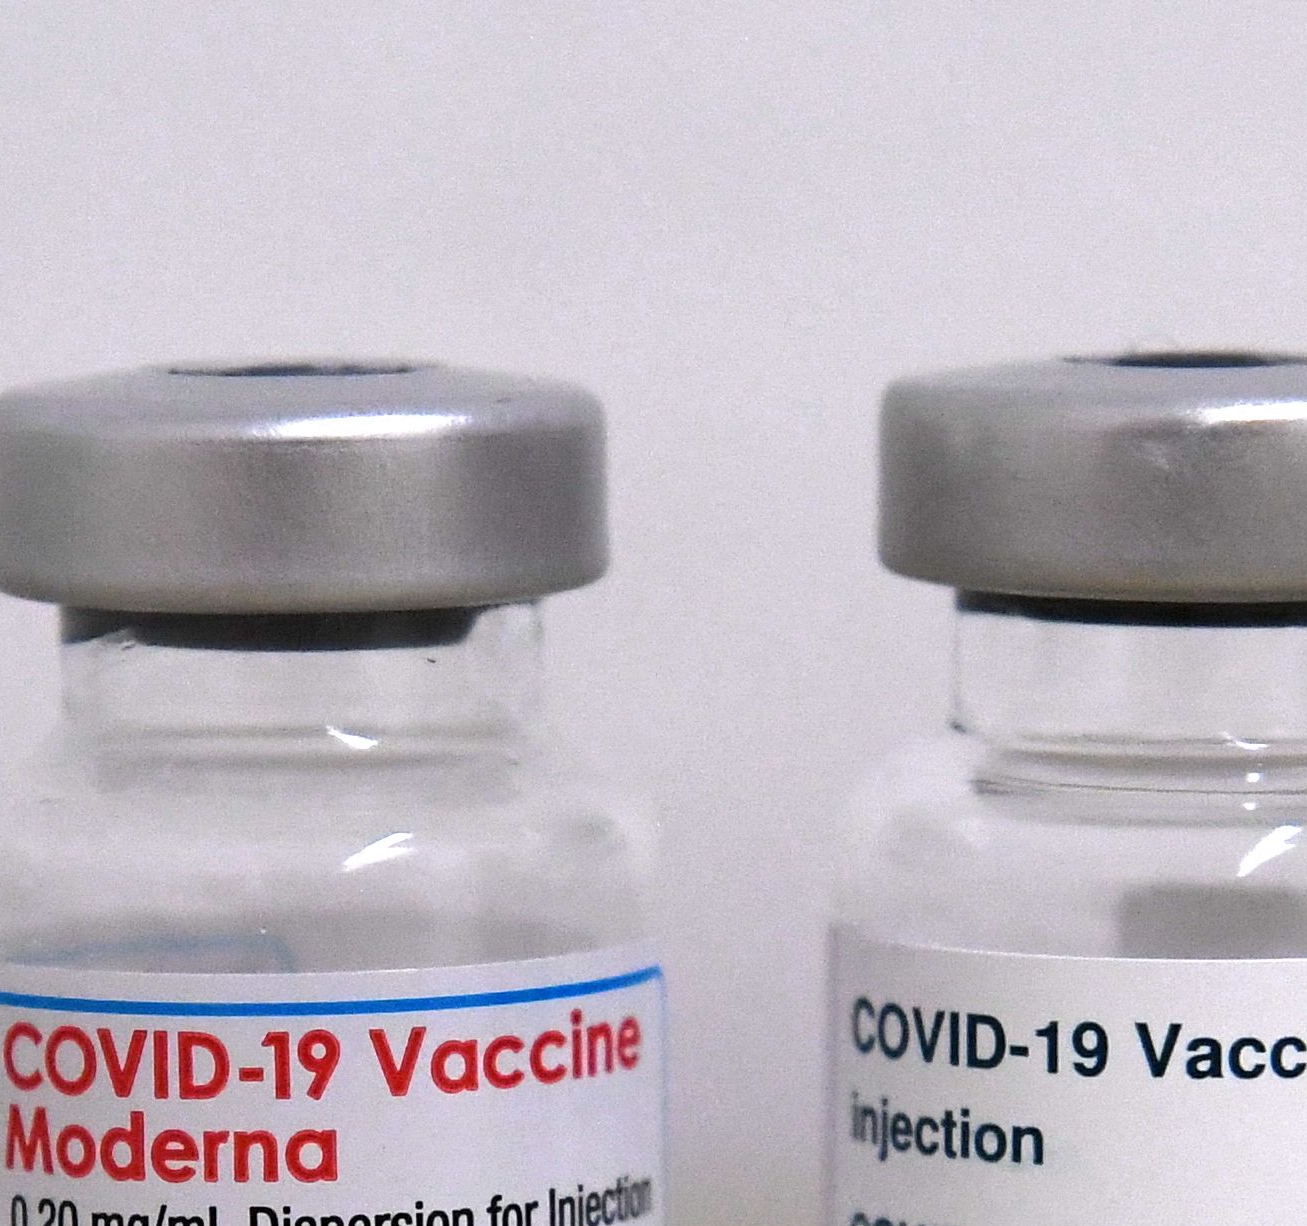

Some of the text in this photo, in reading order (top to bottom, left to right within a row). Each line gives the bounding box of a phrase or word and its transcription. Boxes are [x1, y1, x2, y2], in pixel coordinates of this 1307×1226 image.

[1, 1008, 644, 1103] COVID-19 Vaccine
[851, 995, 1110, 1077] COVID-19
[3, 1102, 339, 1184] Moderna
[851, 1090, 1046, 1167] injection
